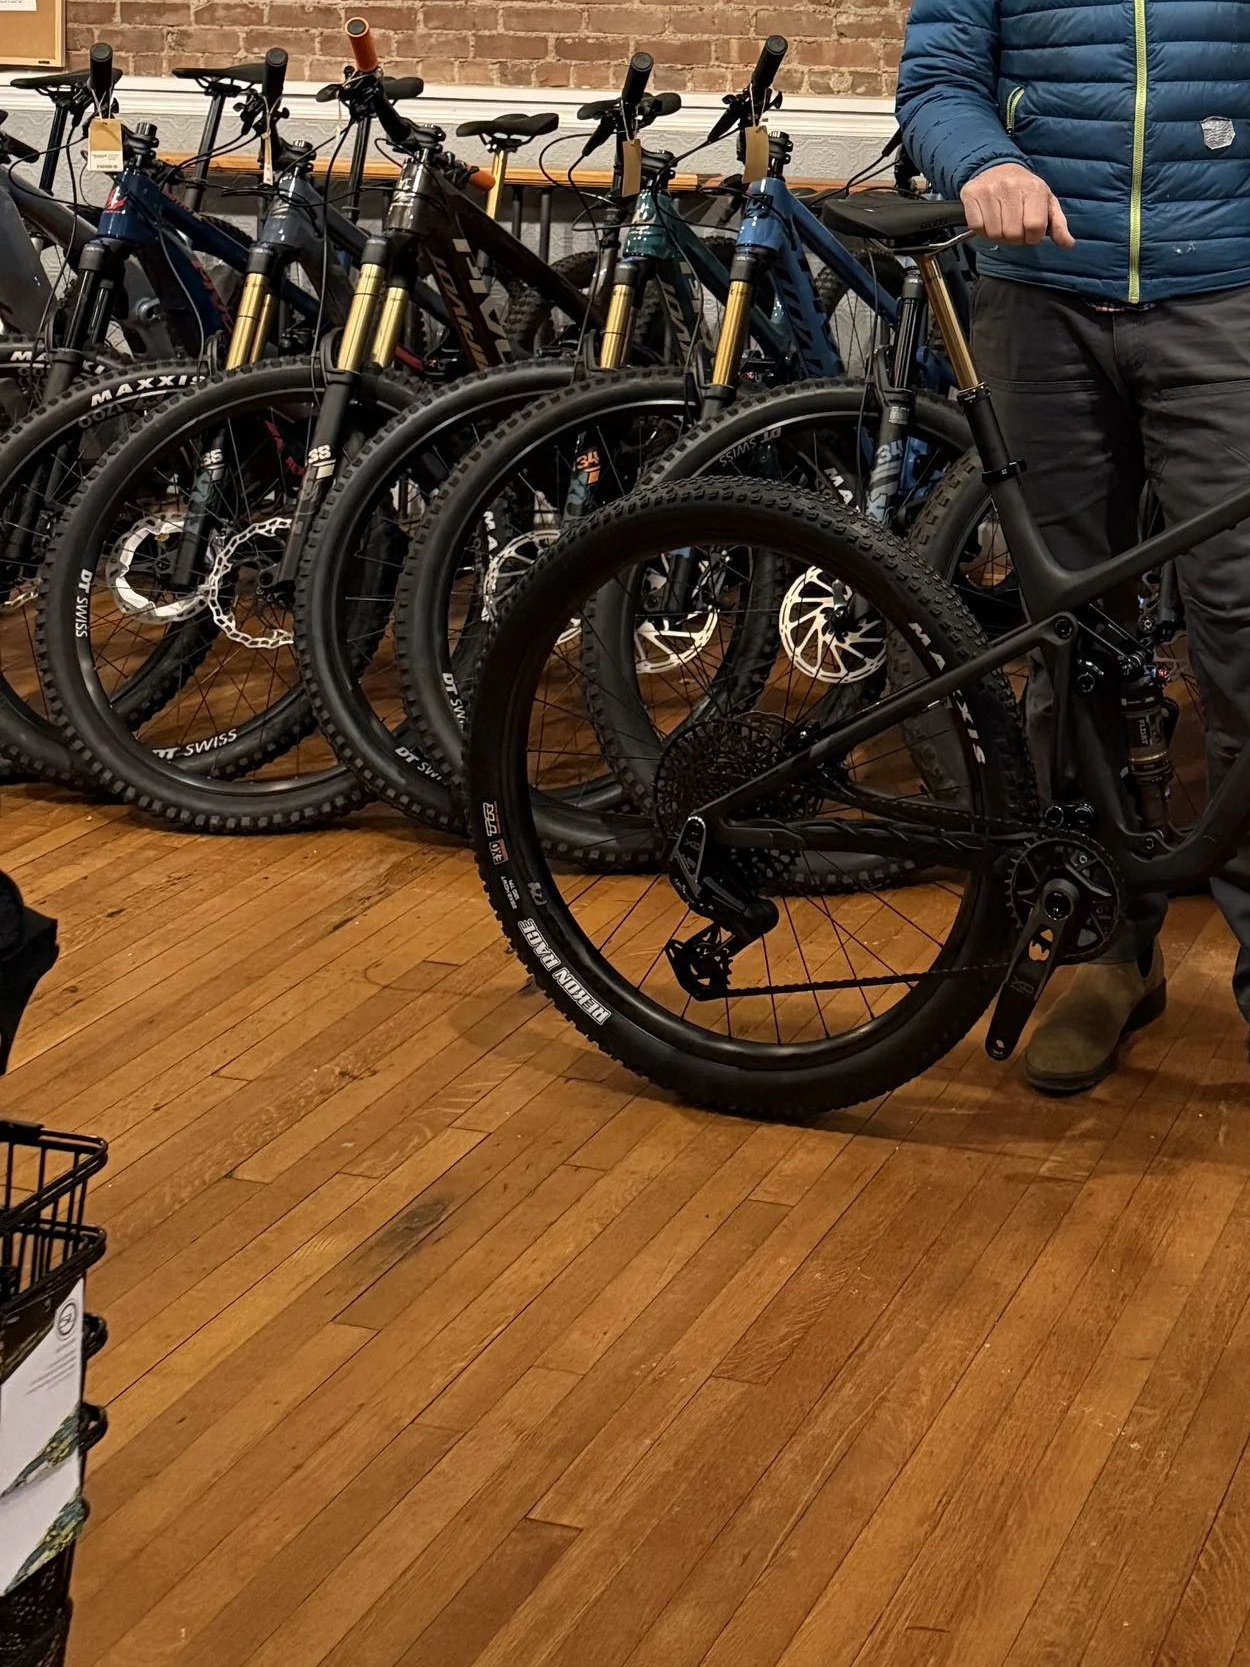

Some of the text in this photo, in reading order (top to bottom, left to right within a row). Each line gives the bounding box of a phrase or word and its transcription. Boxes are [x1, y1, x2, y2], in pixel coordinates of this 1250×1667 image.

[719, 437, 757, 467] SWISS
[75, 568, 93, 638] DT SWISS
[441, 672, 457, 694] DT
[907, 622, 986, 764] MAXIS
[184, 729, 237, 757] SWISS
[394, 746, 419, 764] DT
[517, 918, 612, 1026] REKON RACE
